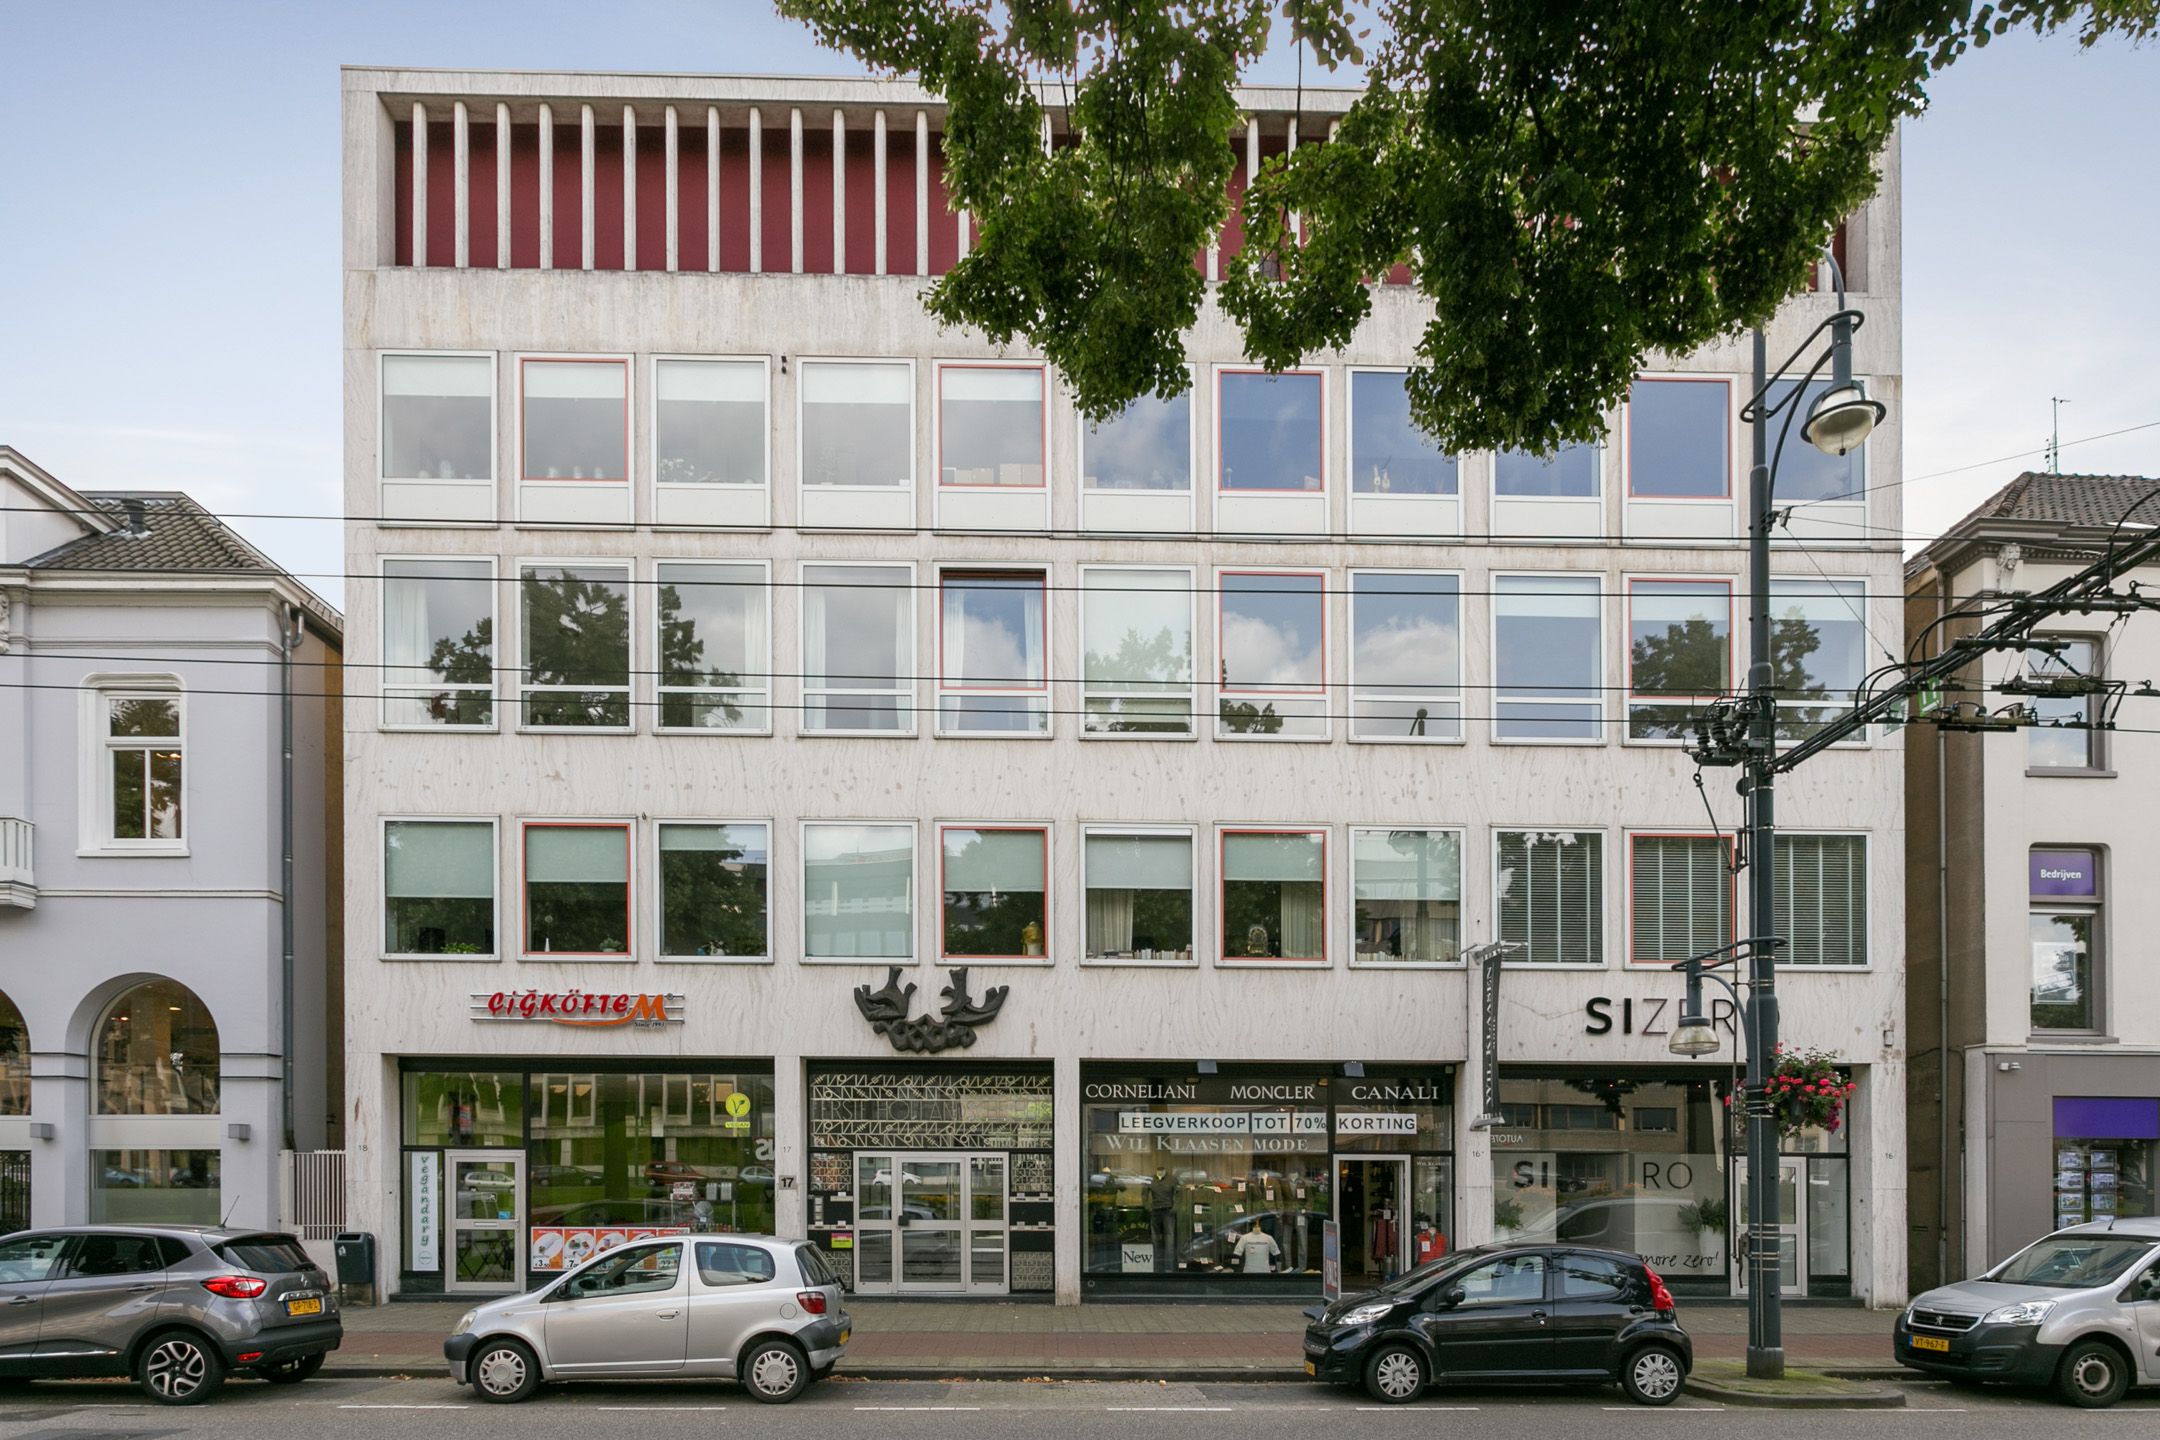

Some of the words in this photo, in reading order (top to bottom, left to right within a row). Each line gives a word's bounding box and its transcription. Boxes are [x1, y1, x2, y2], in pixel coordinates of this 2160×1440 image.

[2040, 868, 2082, 881] Bedrijven
[1085, 1084, 1196, 1099] CORNELIANI
[1230, 1085, 1316, 1100] MONCLER
[1351, 1085, 1439, 1100] CANALI
[1121, 1117, 1246, 1129] LEEGVERKOOP
[1254, 1117, 1287, 1129] TOT
[1295, 1117, 1326, 1129] 70%
[1338, 1117, 1415, 1130] KORTING
[1885, 1152, 1894, 1160] 16
[1513, 1161, 1549, 1188] SI
[1643, 1162, 1693, 1189] RO
[781, 1177, 794, 1188] 17
[421, 1155, 430, 1247] vegandary
[1123, 1250, 1153, 1264] New
